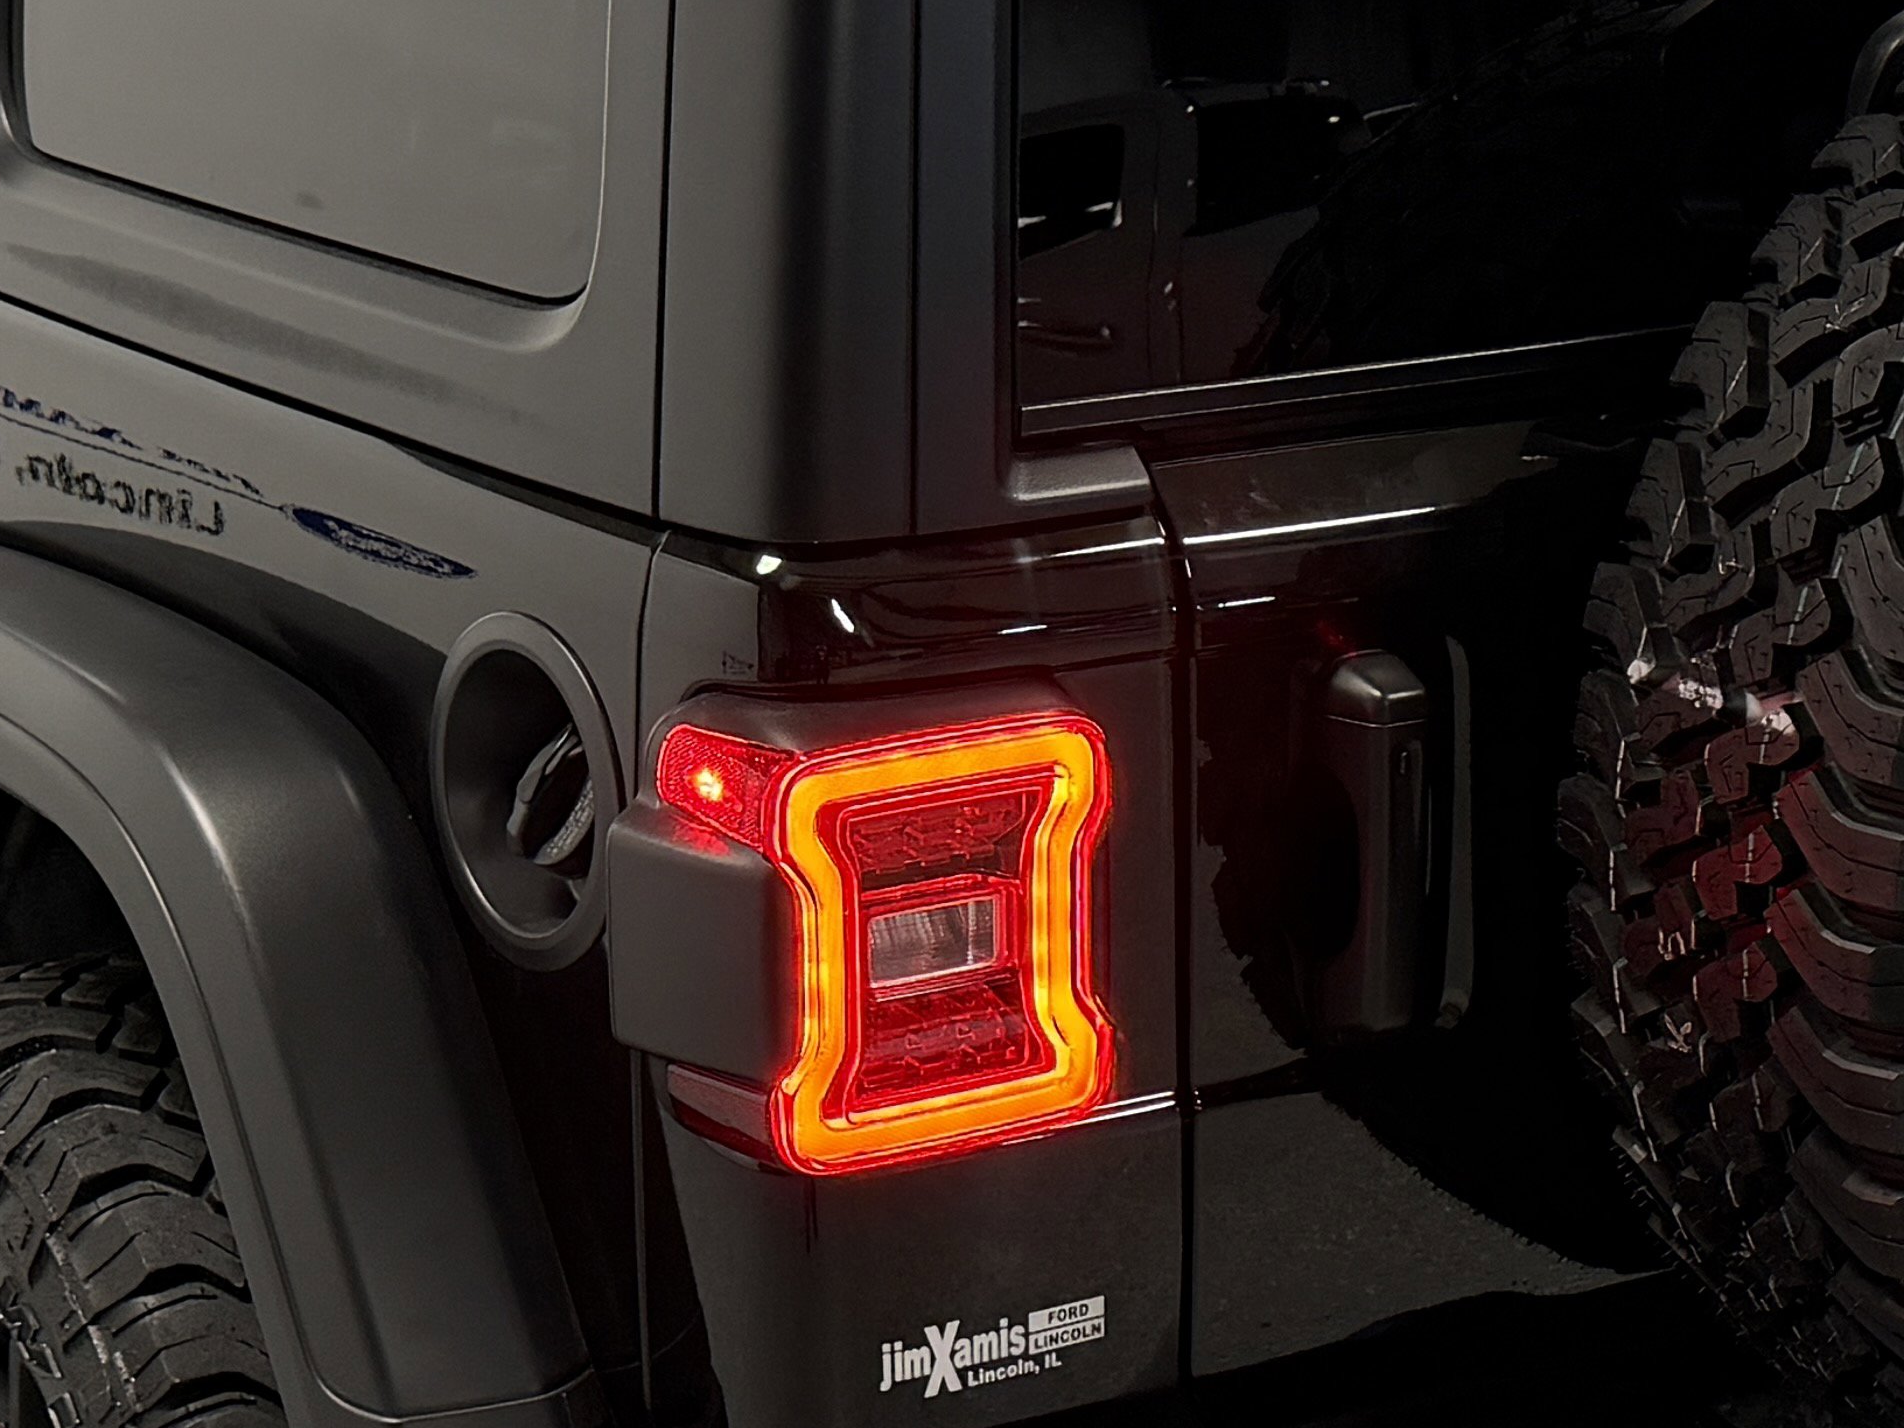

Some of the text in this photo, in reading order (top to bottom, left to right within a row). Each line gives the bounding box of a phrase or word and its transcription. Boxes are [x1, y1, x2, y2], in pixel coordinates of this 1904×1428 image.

[1048, 1303, 1089, 1324] FORD
[1033, 1322, 1102, 1350] LINCOLN
[967, 1352, 1062, 1387] Lincoln, IL
